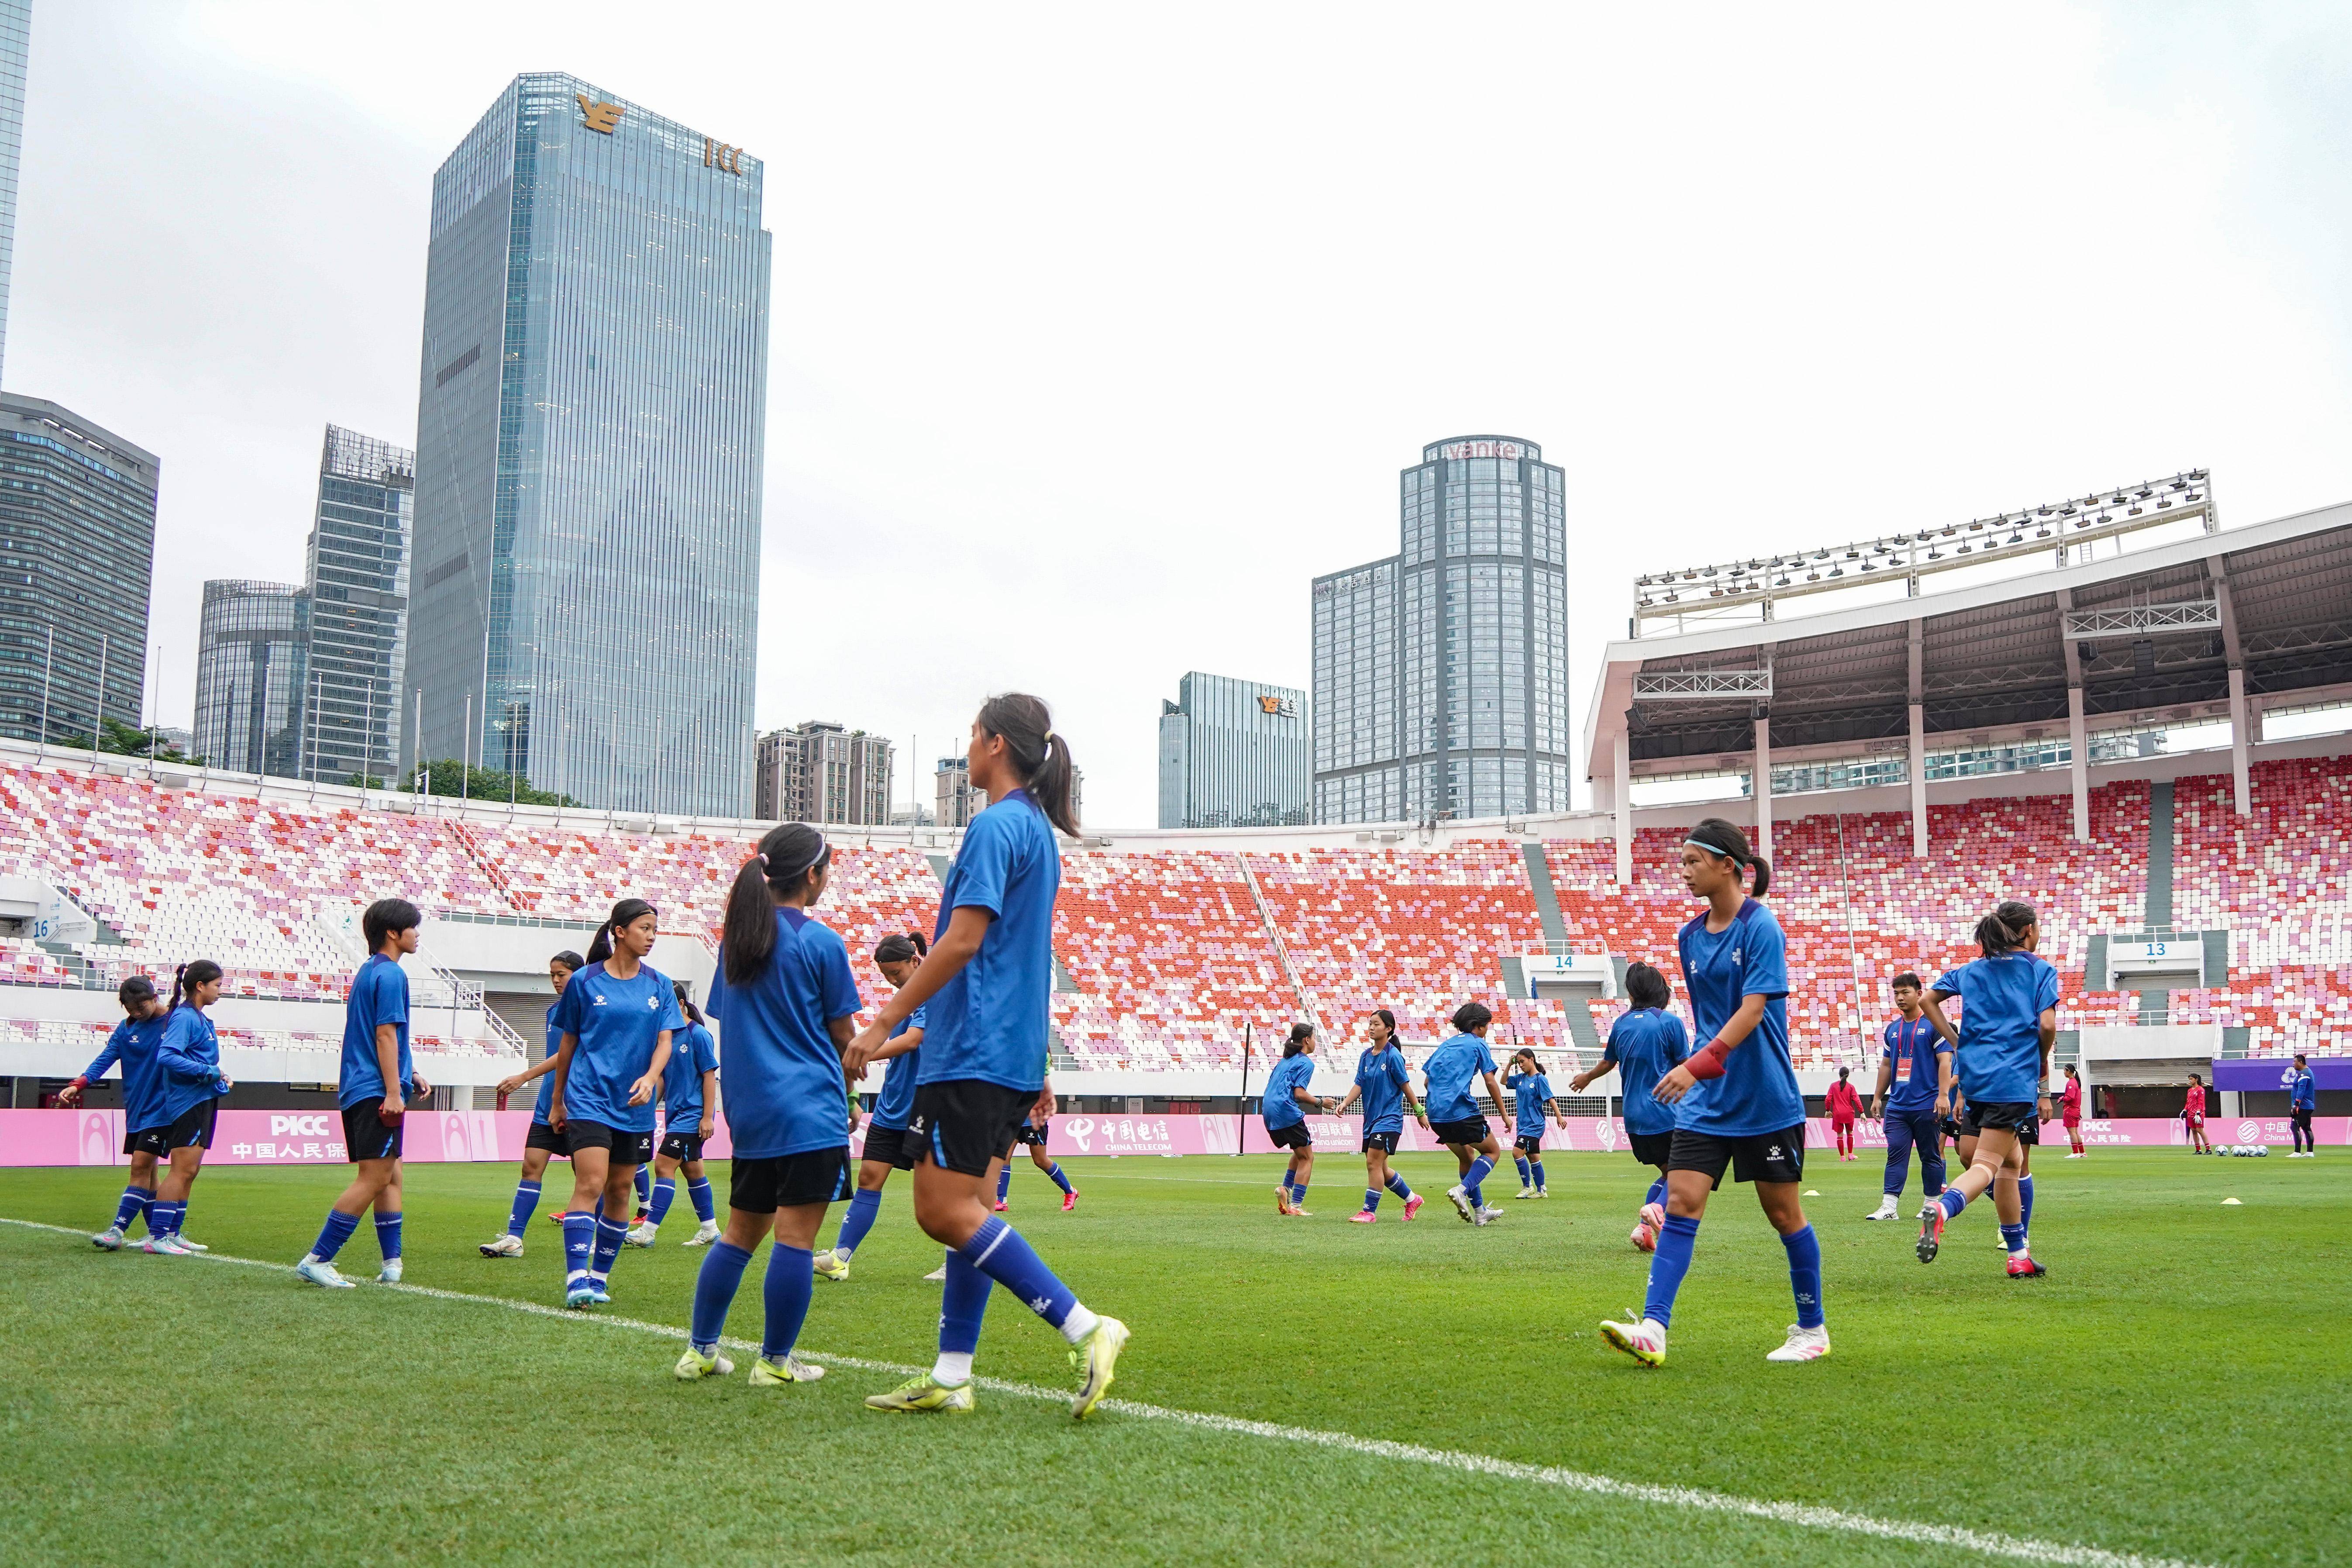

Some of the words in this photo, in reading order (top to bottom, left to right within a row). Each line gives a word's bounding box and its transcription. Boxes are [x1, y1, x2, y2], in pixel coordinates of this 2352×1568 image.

[705, 138, 743, 176] ICC
[1449, 442, 1515, 459] vanke
[334, 443, 416, 478] WESTI
[34, 920, 48, 937] 16
[2147, 943, 2165, 955] 13
[1556, 956, 1573, 968] 14
[271, 1116, 329, 1136] PICC
[1102, 1119, 1169, 1143] 中国电信
[1308, 1123, 1353, 1136] 中国联通
[2082, 1121, 2111, 1132] PICC
[2063, 1134, 2131, 1143] 中人民保险
[232, 1142, 347, 1159] 中国人民保
